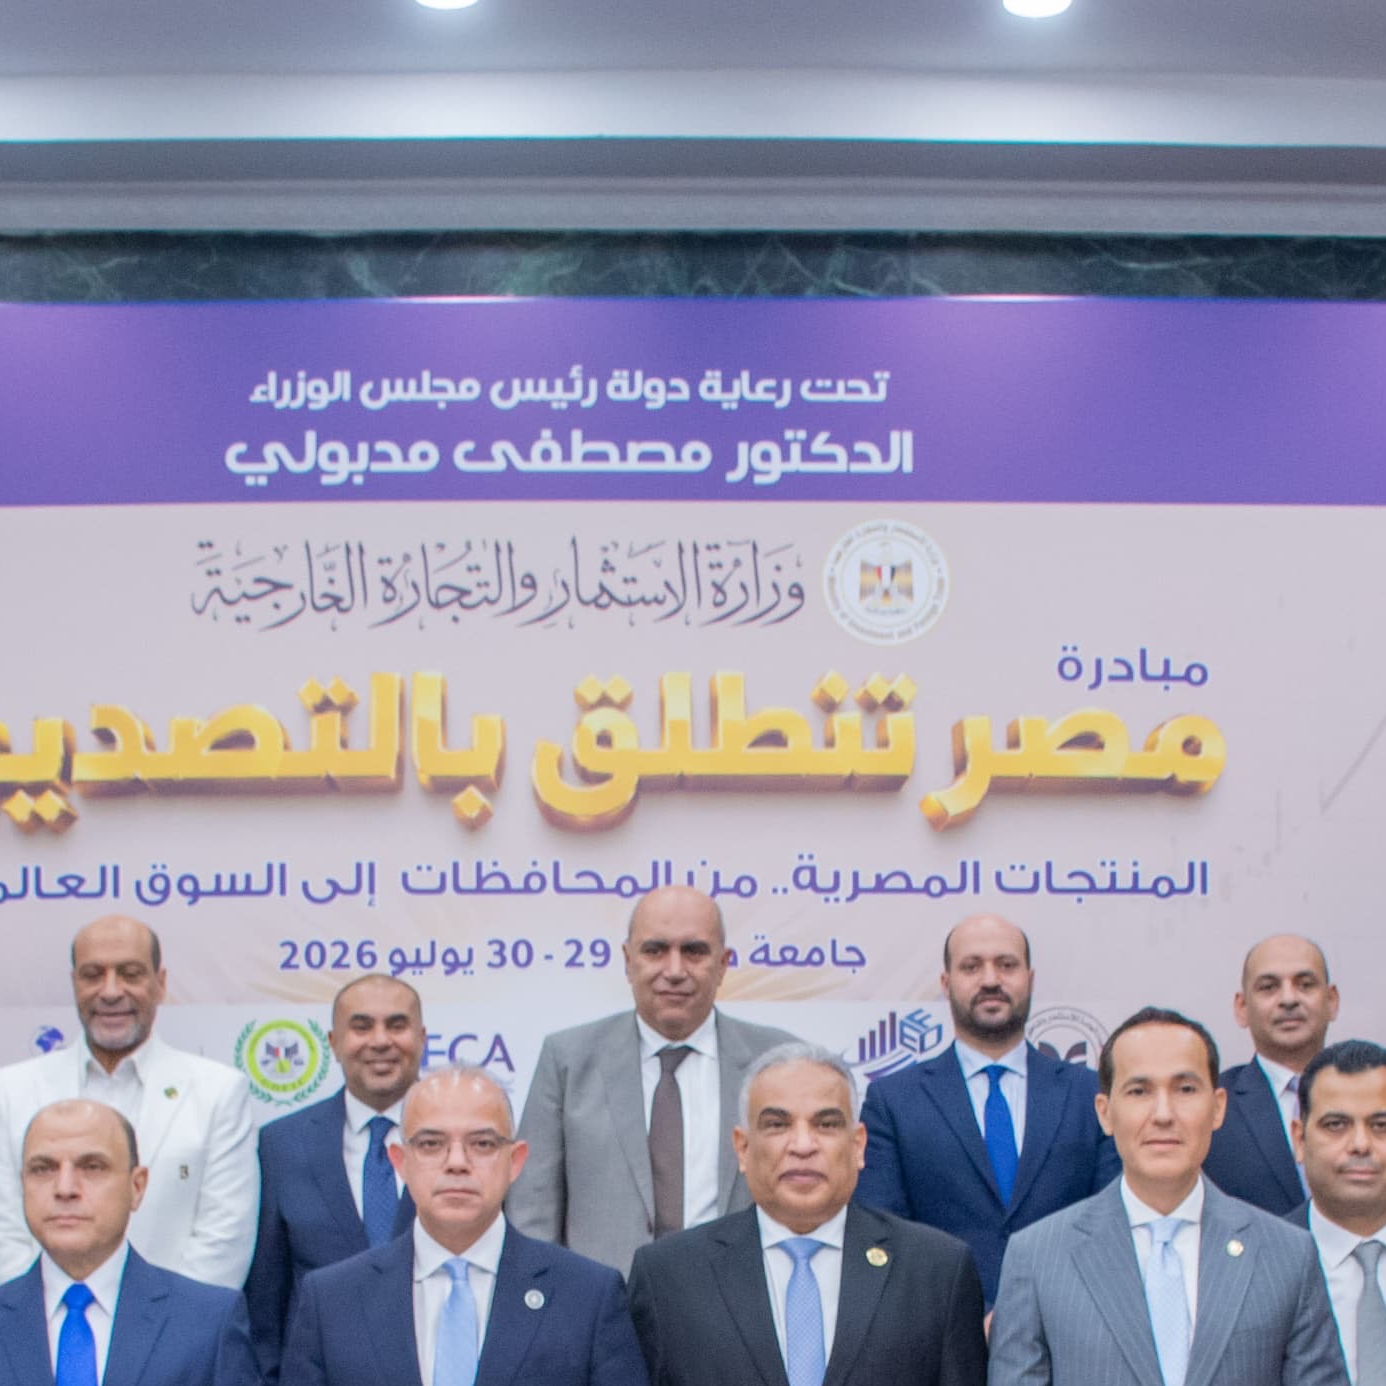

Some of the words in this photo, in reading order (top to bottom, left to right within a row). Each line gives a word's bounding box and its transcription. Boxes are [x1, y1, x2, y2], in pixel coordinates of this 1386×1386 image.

[249, 370, 351, 410] الوزراء
[359, 370, 481, 410] مجلس
[489, 364, 598, 410] رئيس
[606, 370, 691, 410] دولة
[699, 370, 792, 410] رعاية
[800, 371, 891, 402] تحت
[224, 430, 440, 486] مدبولي
[453, 428, 712, 472] مصطفى
[725, 429, 913, 484] الدكتور
[1056, 646, 1209, 690] مبادرة
[531, 670, 917, 833] تنطلق
[919, 708, 1227, 832] مصر
[134, 862, 287, 906] السوق
[301, 862, 377, 907] إلى
[401, 859, 673, 898] المحافظات
[995, 860, 1209, 903] المنتجات
[279, 940, 379, 970] 2026
[387, 940, 475, 976] يوليو
[487, 940, 535, 970] 30
[564, 938, 611, 968] 29
[749, 935, 868, 970] جامعة
